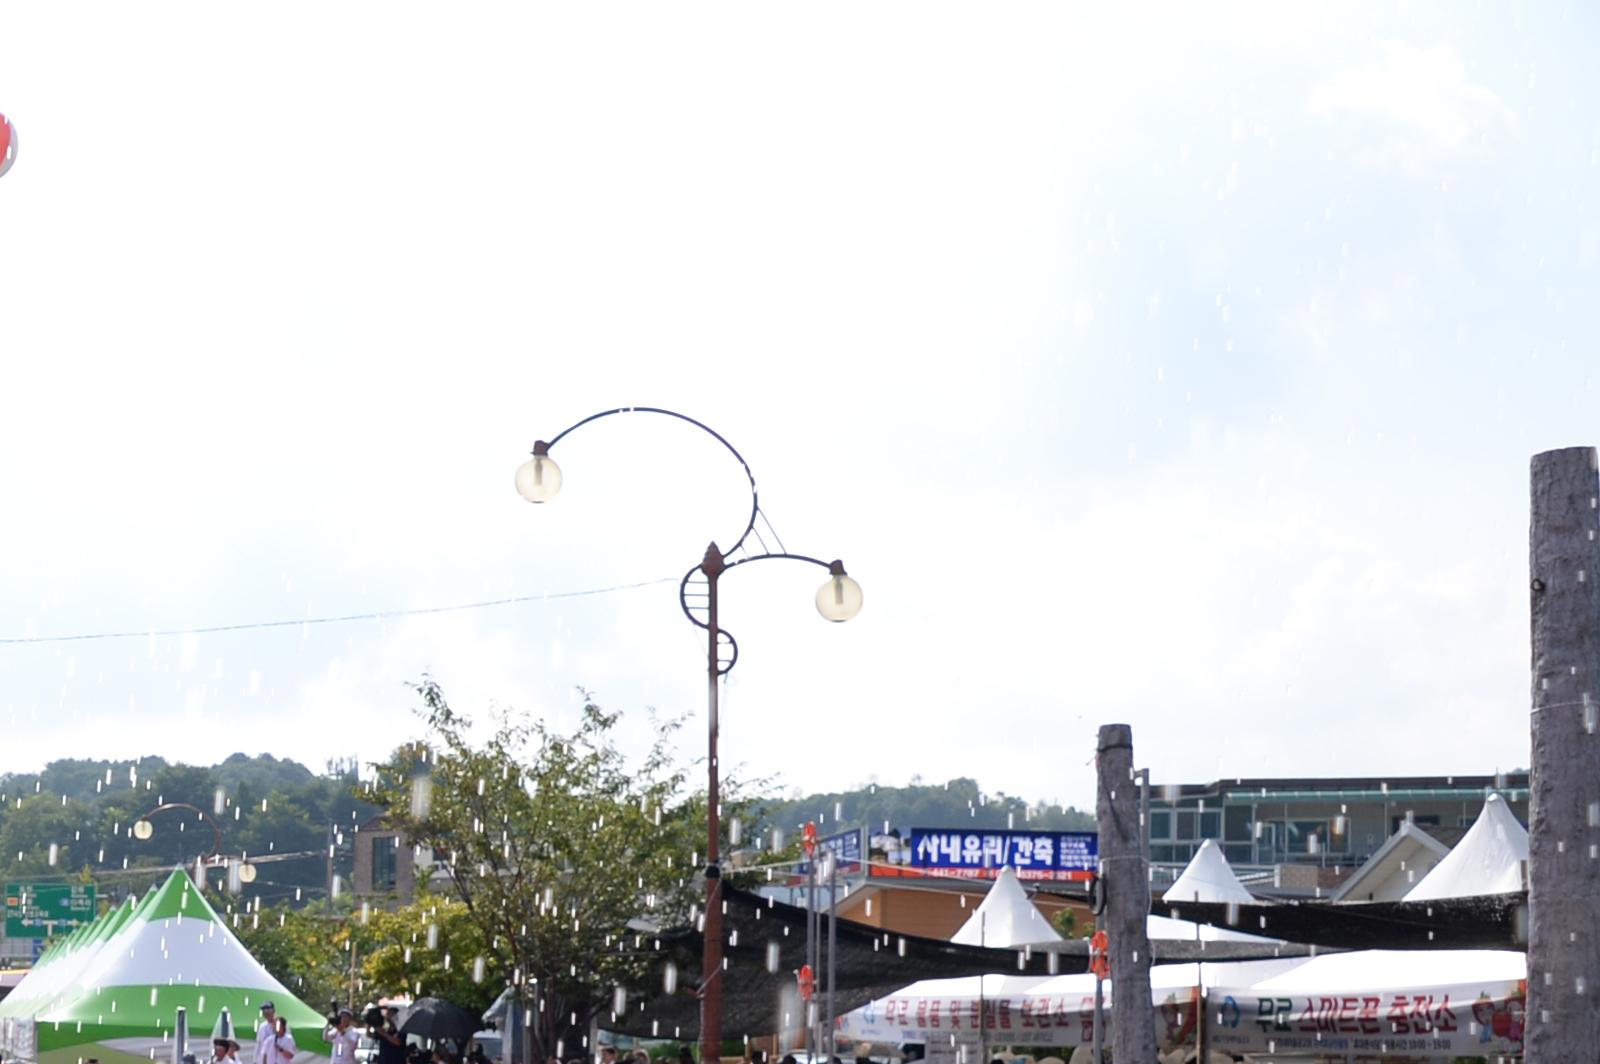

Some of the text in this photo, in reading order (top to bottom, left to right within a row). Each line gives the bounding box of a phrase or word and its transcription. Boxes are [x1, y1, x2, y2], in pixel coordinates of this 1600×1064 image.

[1257, 994, 1458, 1034] 무료 스마트폰 충전소
